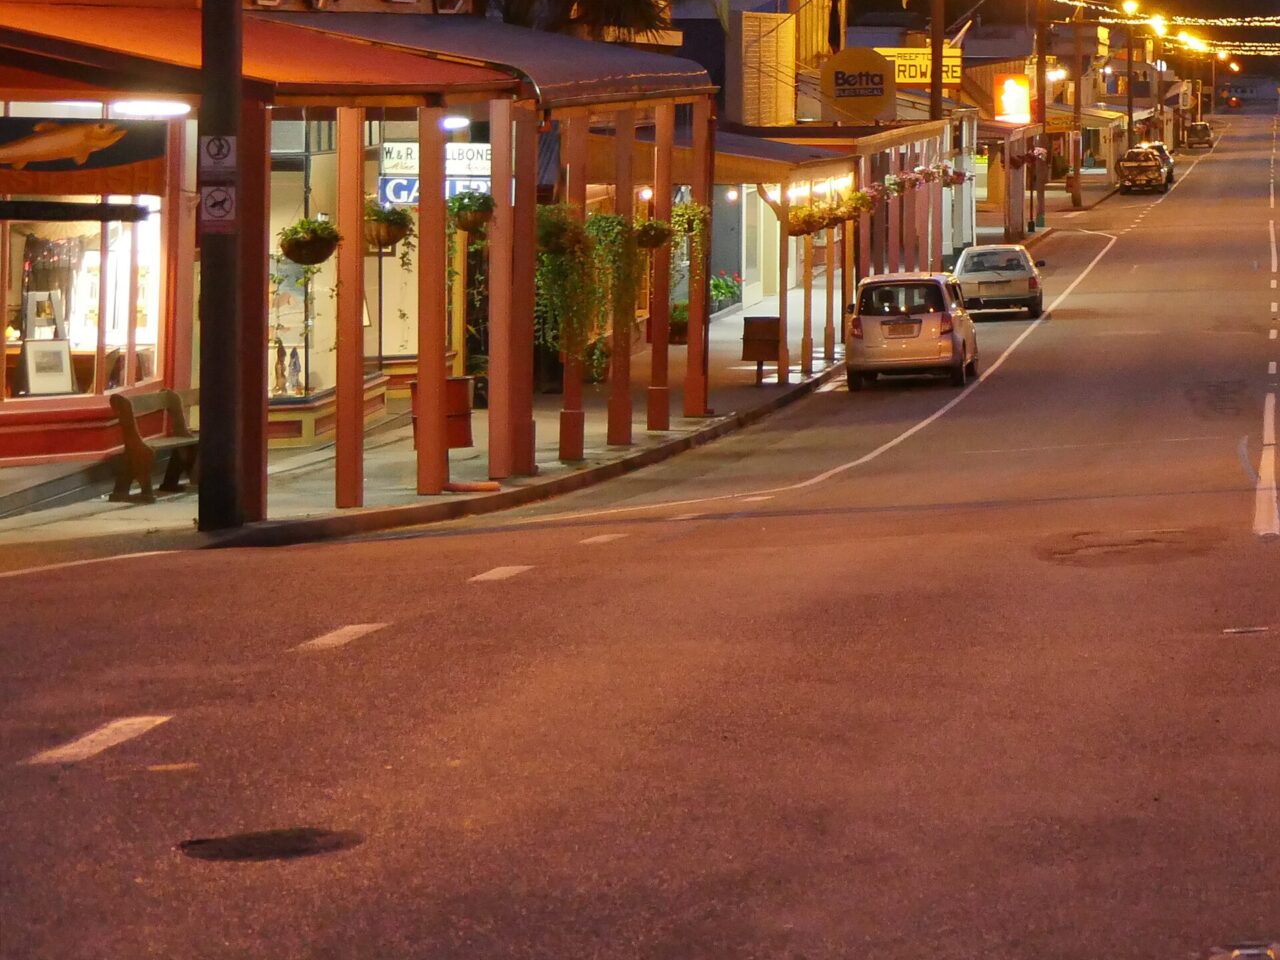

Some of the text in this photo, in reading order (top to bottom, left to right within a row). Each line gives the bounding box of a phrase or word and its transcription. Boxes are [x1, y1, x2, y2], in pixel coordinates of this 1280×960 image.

[897, 53, 932, 61] REEFTO
[835, 71, 884, 86] Betta
[897, 64, 961, 79] RDWRE
